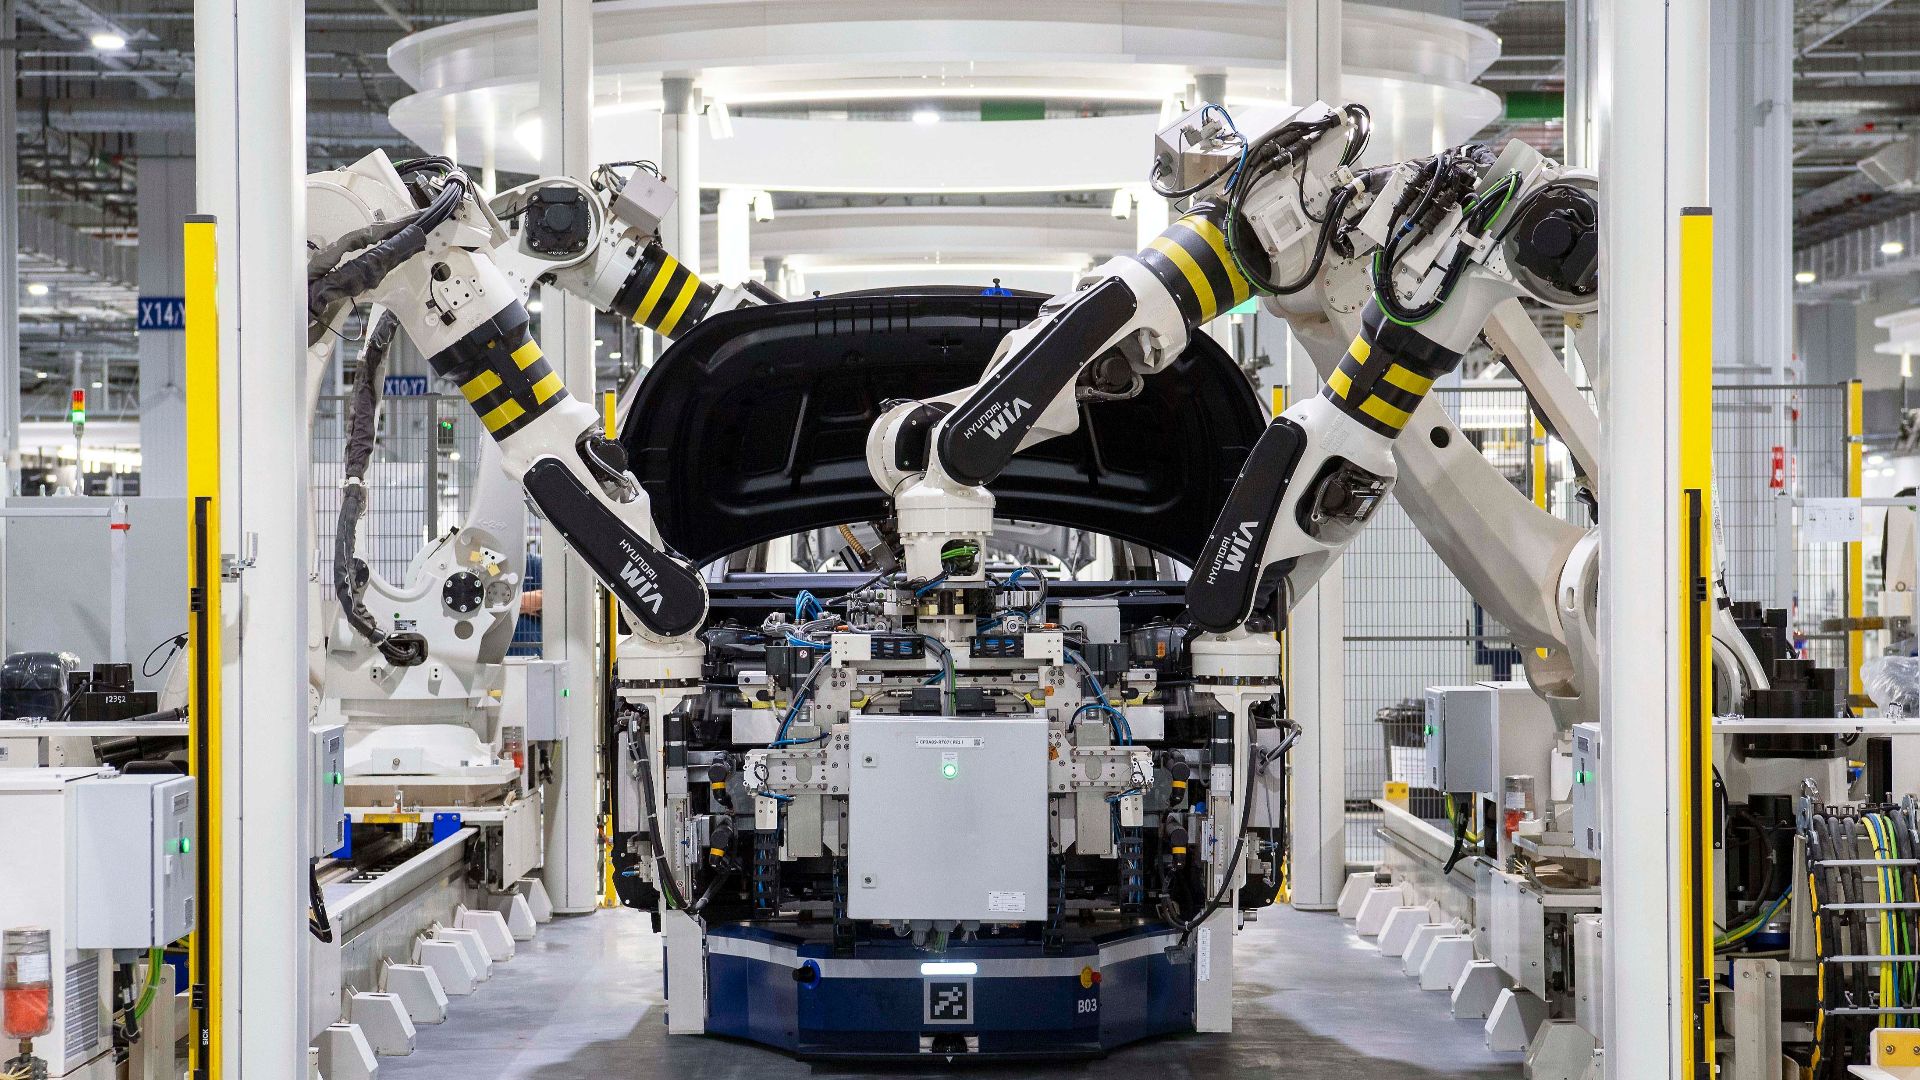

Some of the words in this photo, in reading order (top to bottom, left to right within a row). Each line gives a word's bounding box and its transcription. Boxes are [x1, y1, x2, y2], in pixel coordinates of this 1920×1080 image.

[963, 401, 1002, 440] HYUNDAI
[619, 538, 658, 580] HYUNDAI
[1206, 536, 1231, 585] HYUNDAI
[1078, 998, 1097, 1014] B03
